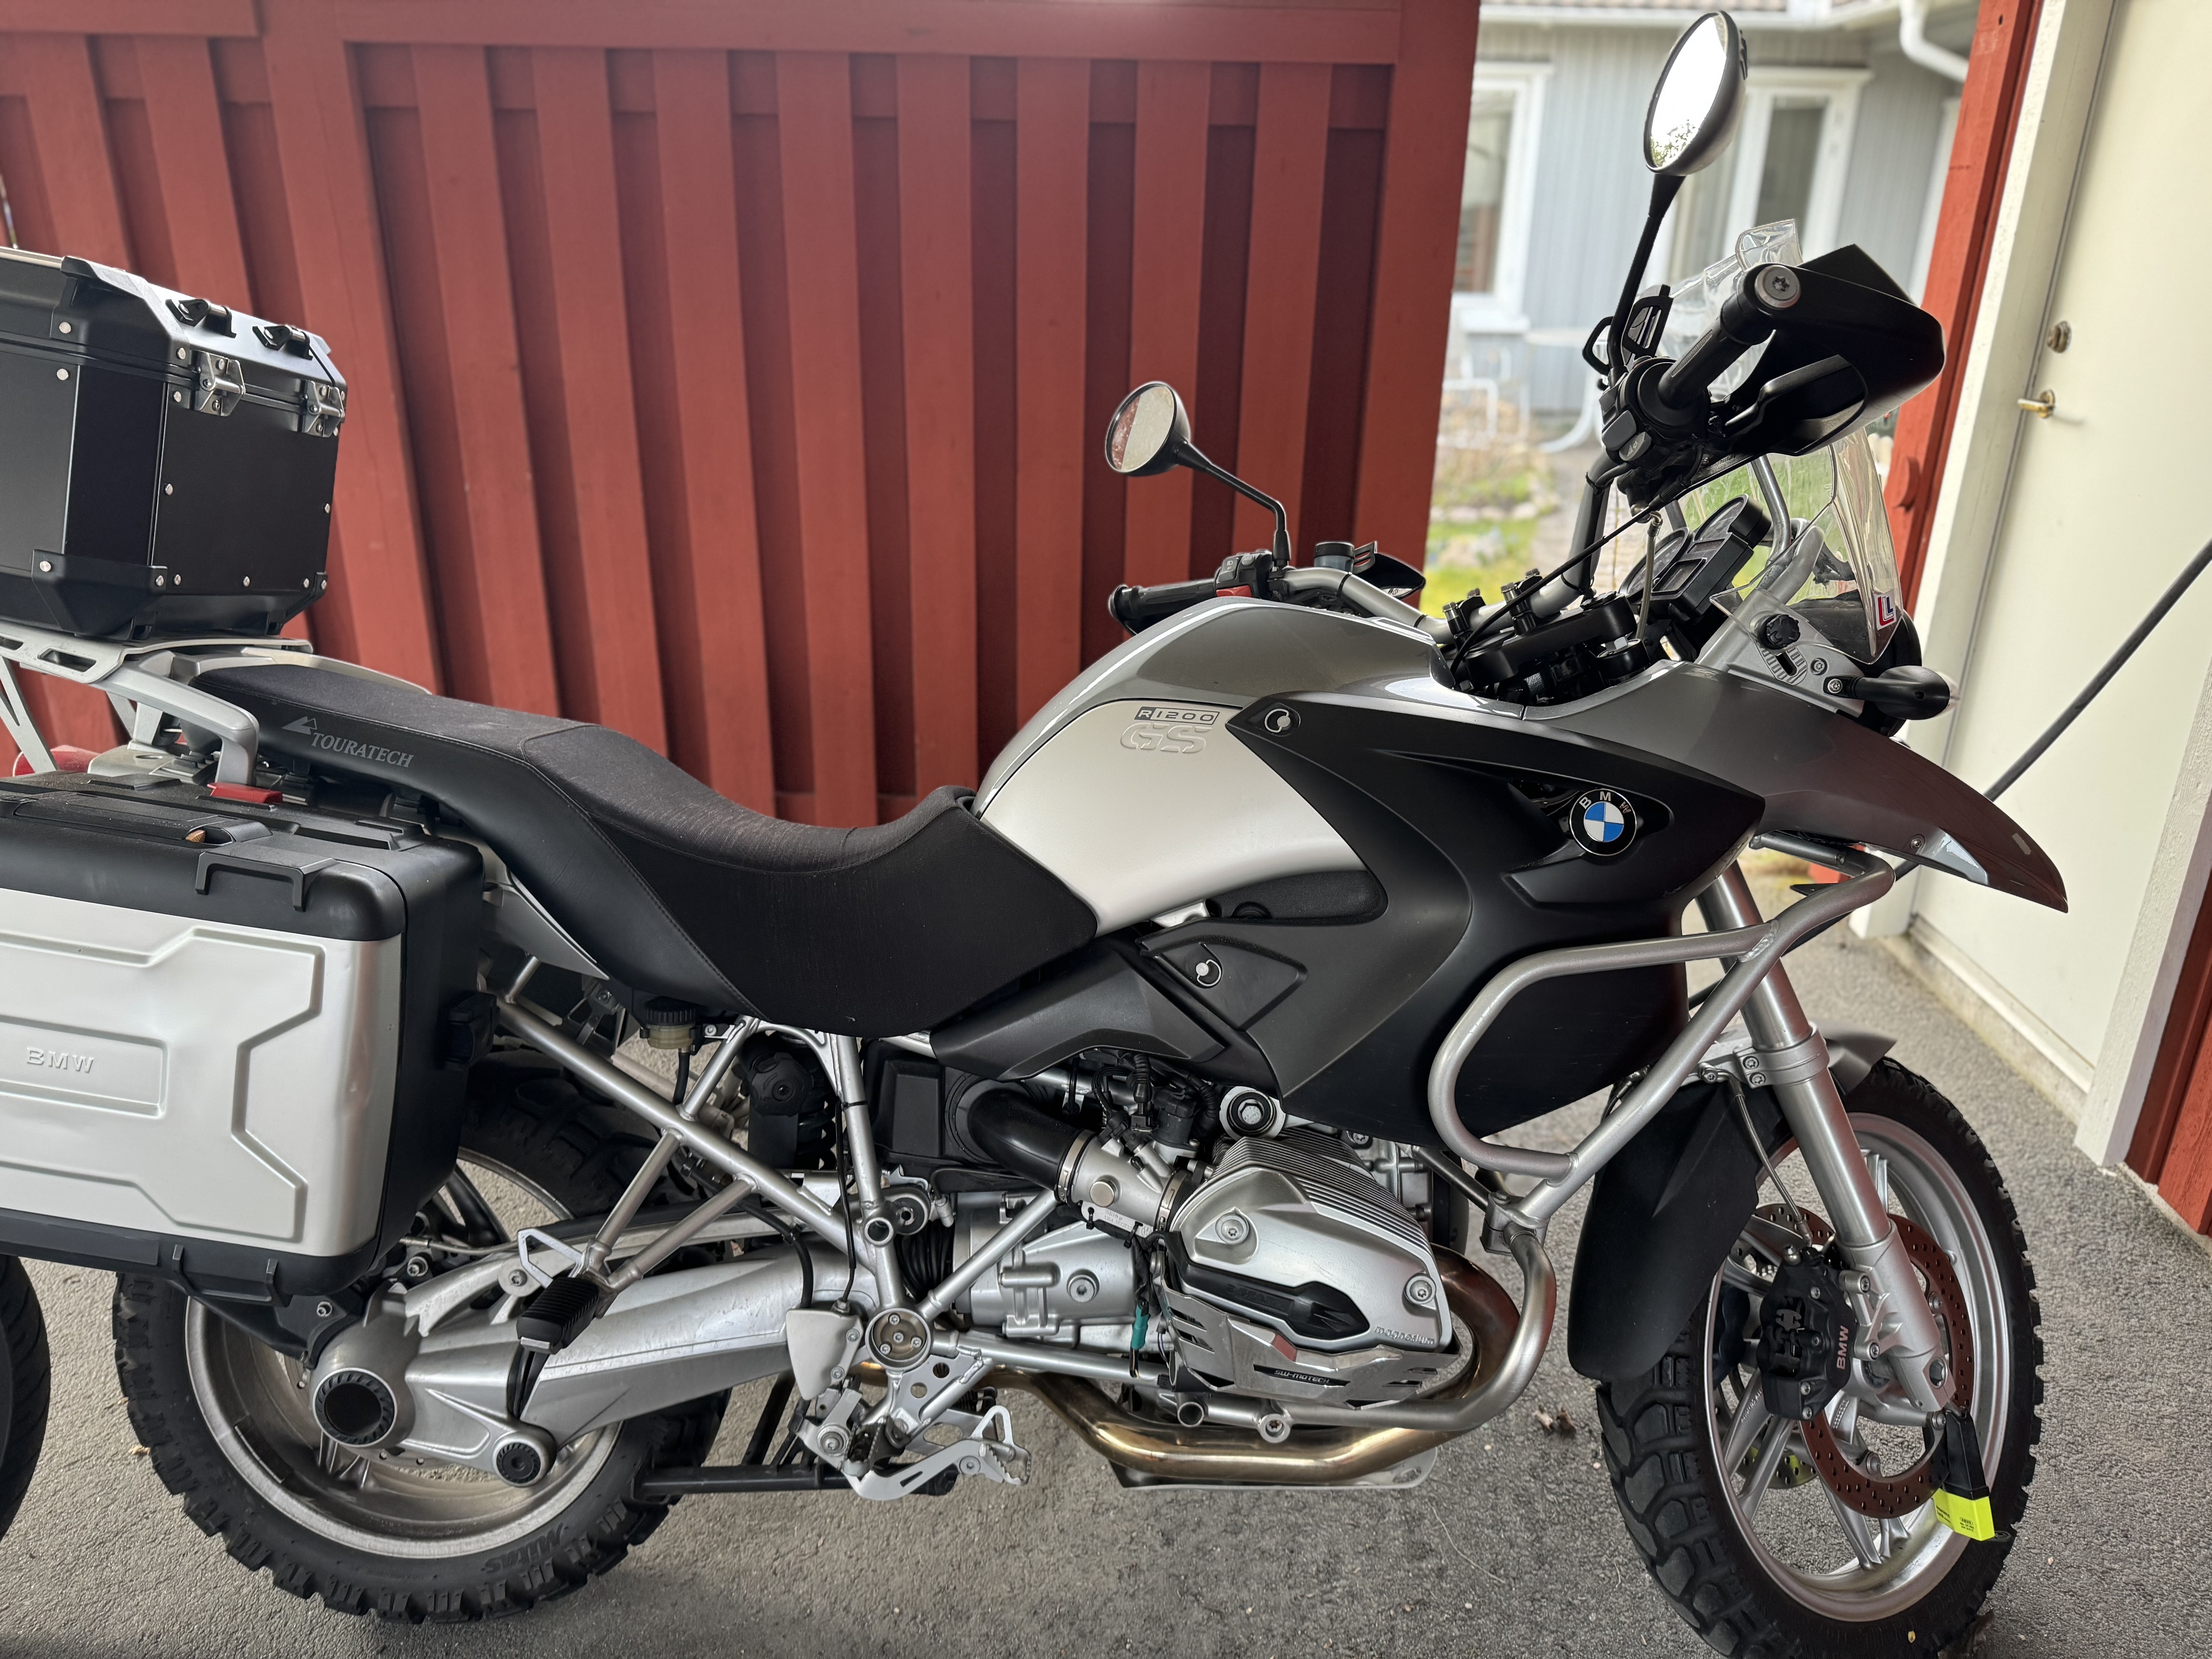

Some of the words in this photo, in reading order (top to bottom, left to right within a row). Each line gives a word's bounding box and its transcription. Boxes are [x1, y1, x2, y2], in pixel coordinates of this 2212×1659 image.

[311, 733, 414, 768] TOURATECH
[1120, 722, 1212, 754] GS
[1579, 791, 1632, 814] BMW
[26, 1047, 94, 1073] BMW
[1374, 1326, 1435, 1345] magnesium
[1837, 1325, 1849, 1370] BMW
[1274, 1370, 1329, 1383] SW-MOTECH
[485, 1522, 564, 1573] Mitas
